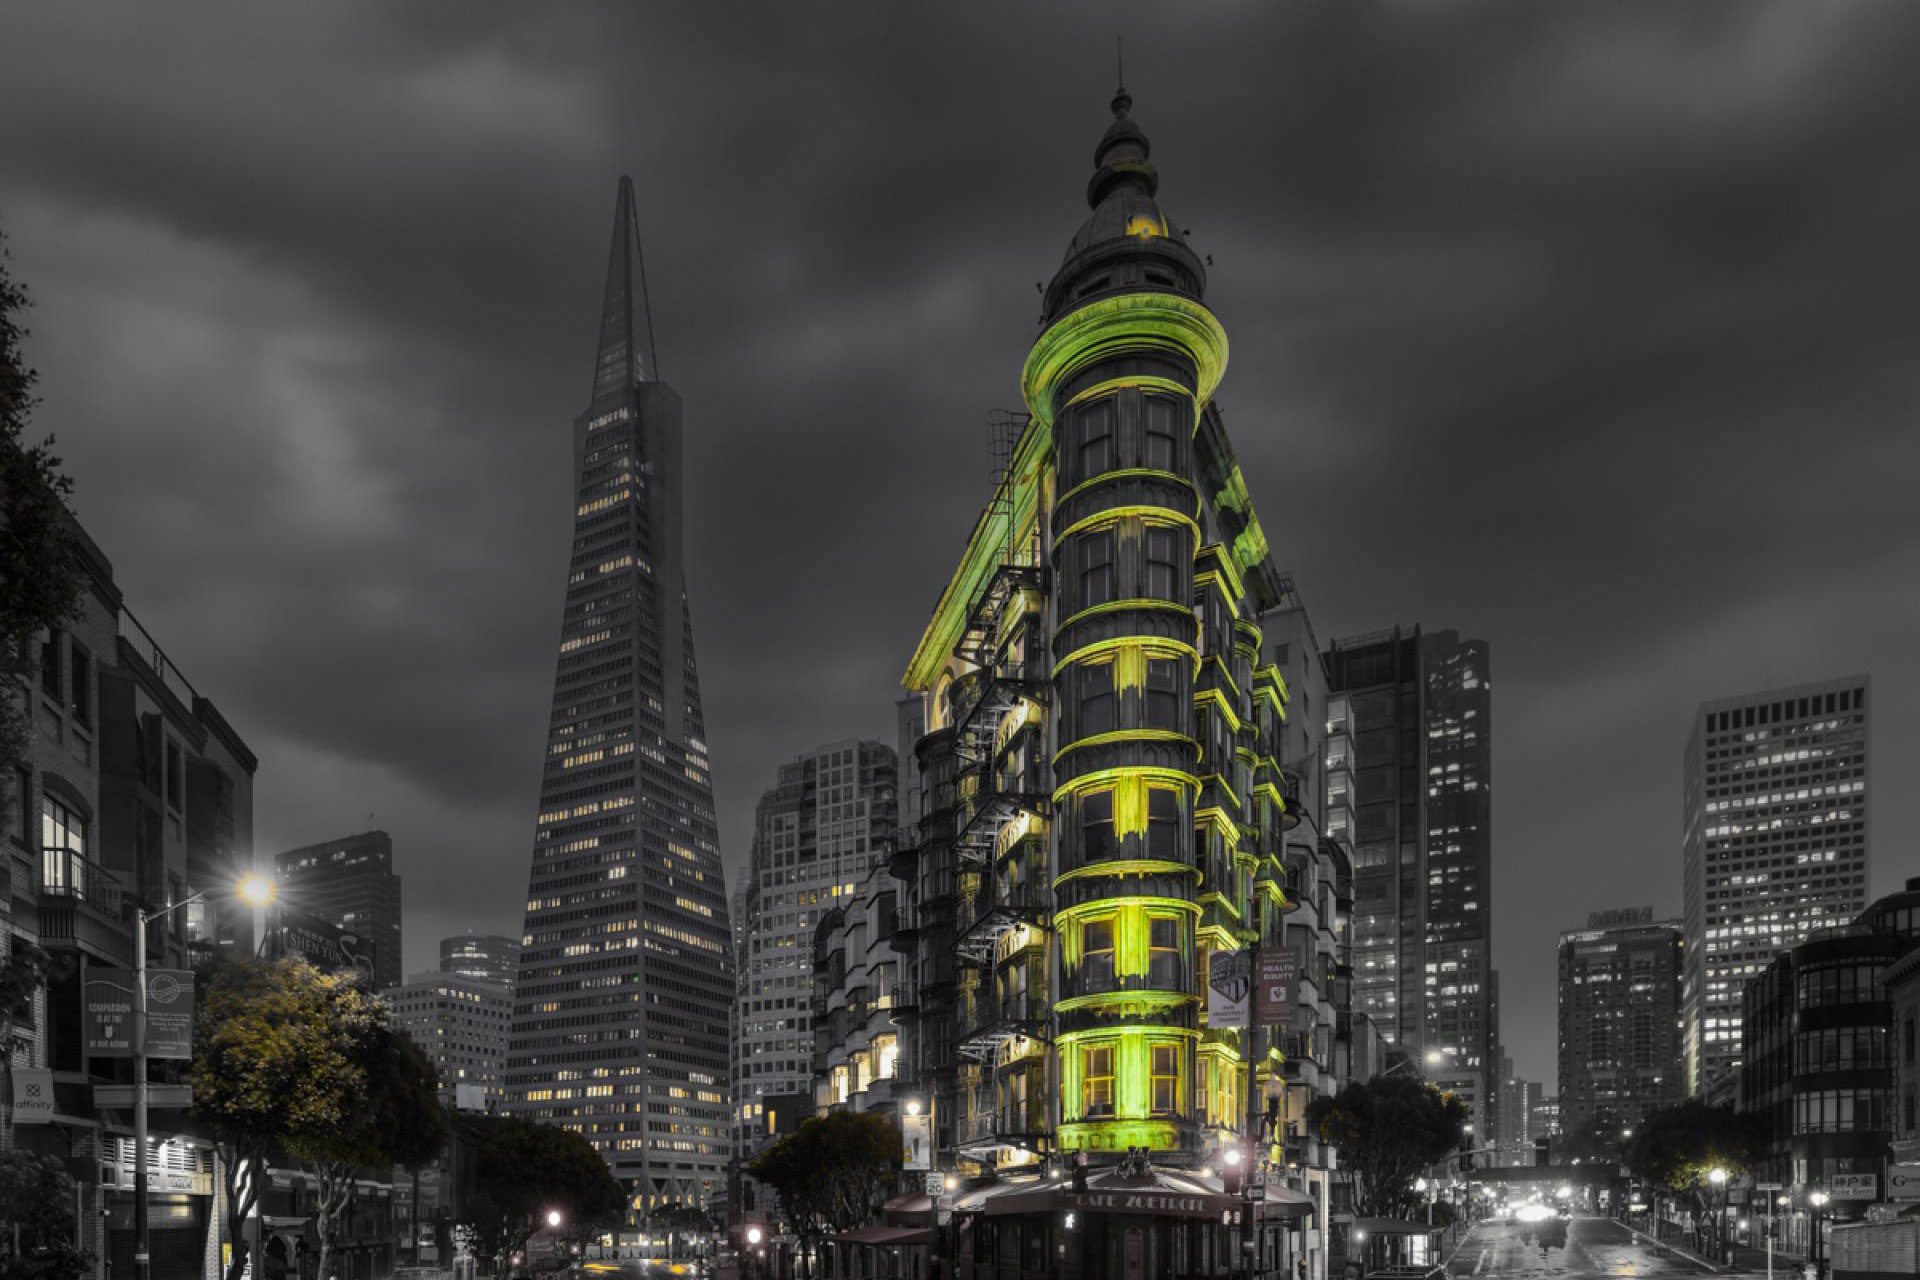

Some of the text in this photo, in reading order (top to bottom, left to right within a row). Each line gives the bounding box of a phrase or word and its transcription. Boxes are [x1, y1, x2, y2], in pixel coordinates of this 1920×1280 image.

[290, 932, 319, 954] SHEN
[321, 944, 344, 964] YUN
[15, 1100, 52, 1111] affinity
[928, 1184, 943, 1193] 20
[1076, 1194, 1206, 1212] CAFE ZOETROPE
